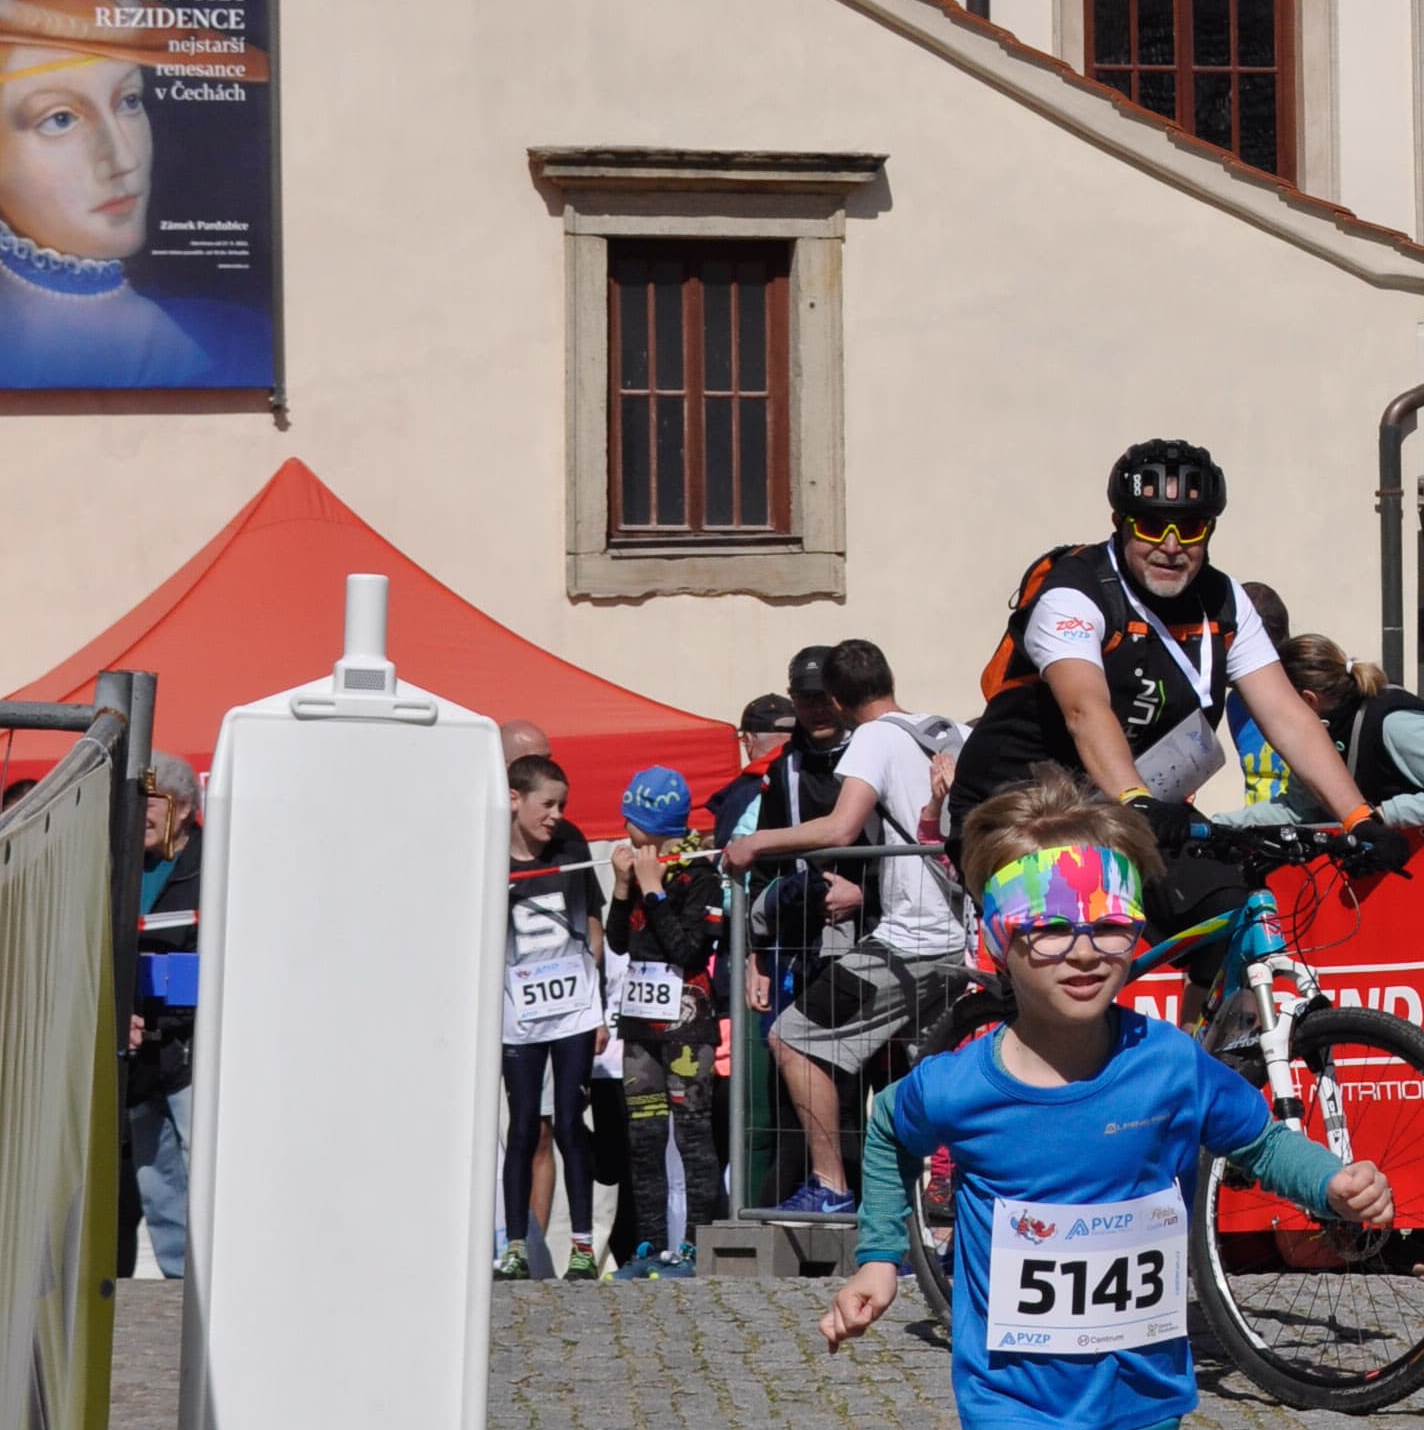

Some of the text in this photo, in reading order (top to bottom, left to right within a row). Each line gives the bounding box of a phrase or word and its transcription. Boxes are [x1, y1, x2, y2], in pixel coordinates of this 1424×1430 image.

[95, 7, 245, 29] REZIDENCE
[168, 37, 246, 56] nejstarší
[156, 64, 246, 77] renesance
[155, 82, 246, 102] v Čechách
[522, 976, 577, 1005] 5107
[627, 981, 671, 1005] 2138
[1091, 1213, 1133, 1231] PVZP
[1018, 1249, 1164, 1315] 5143
[1017, 1333, 1050, 1344] PVZP
